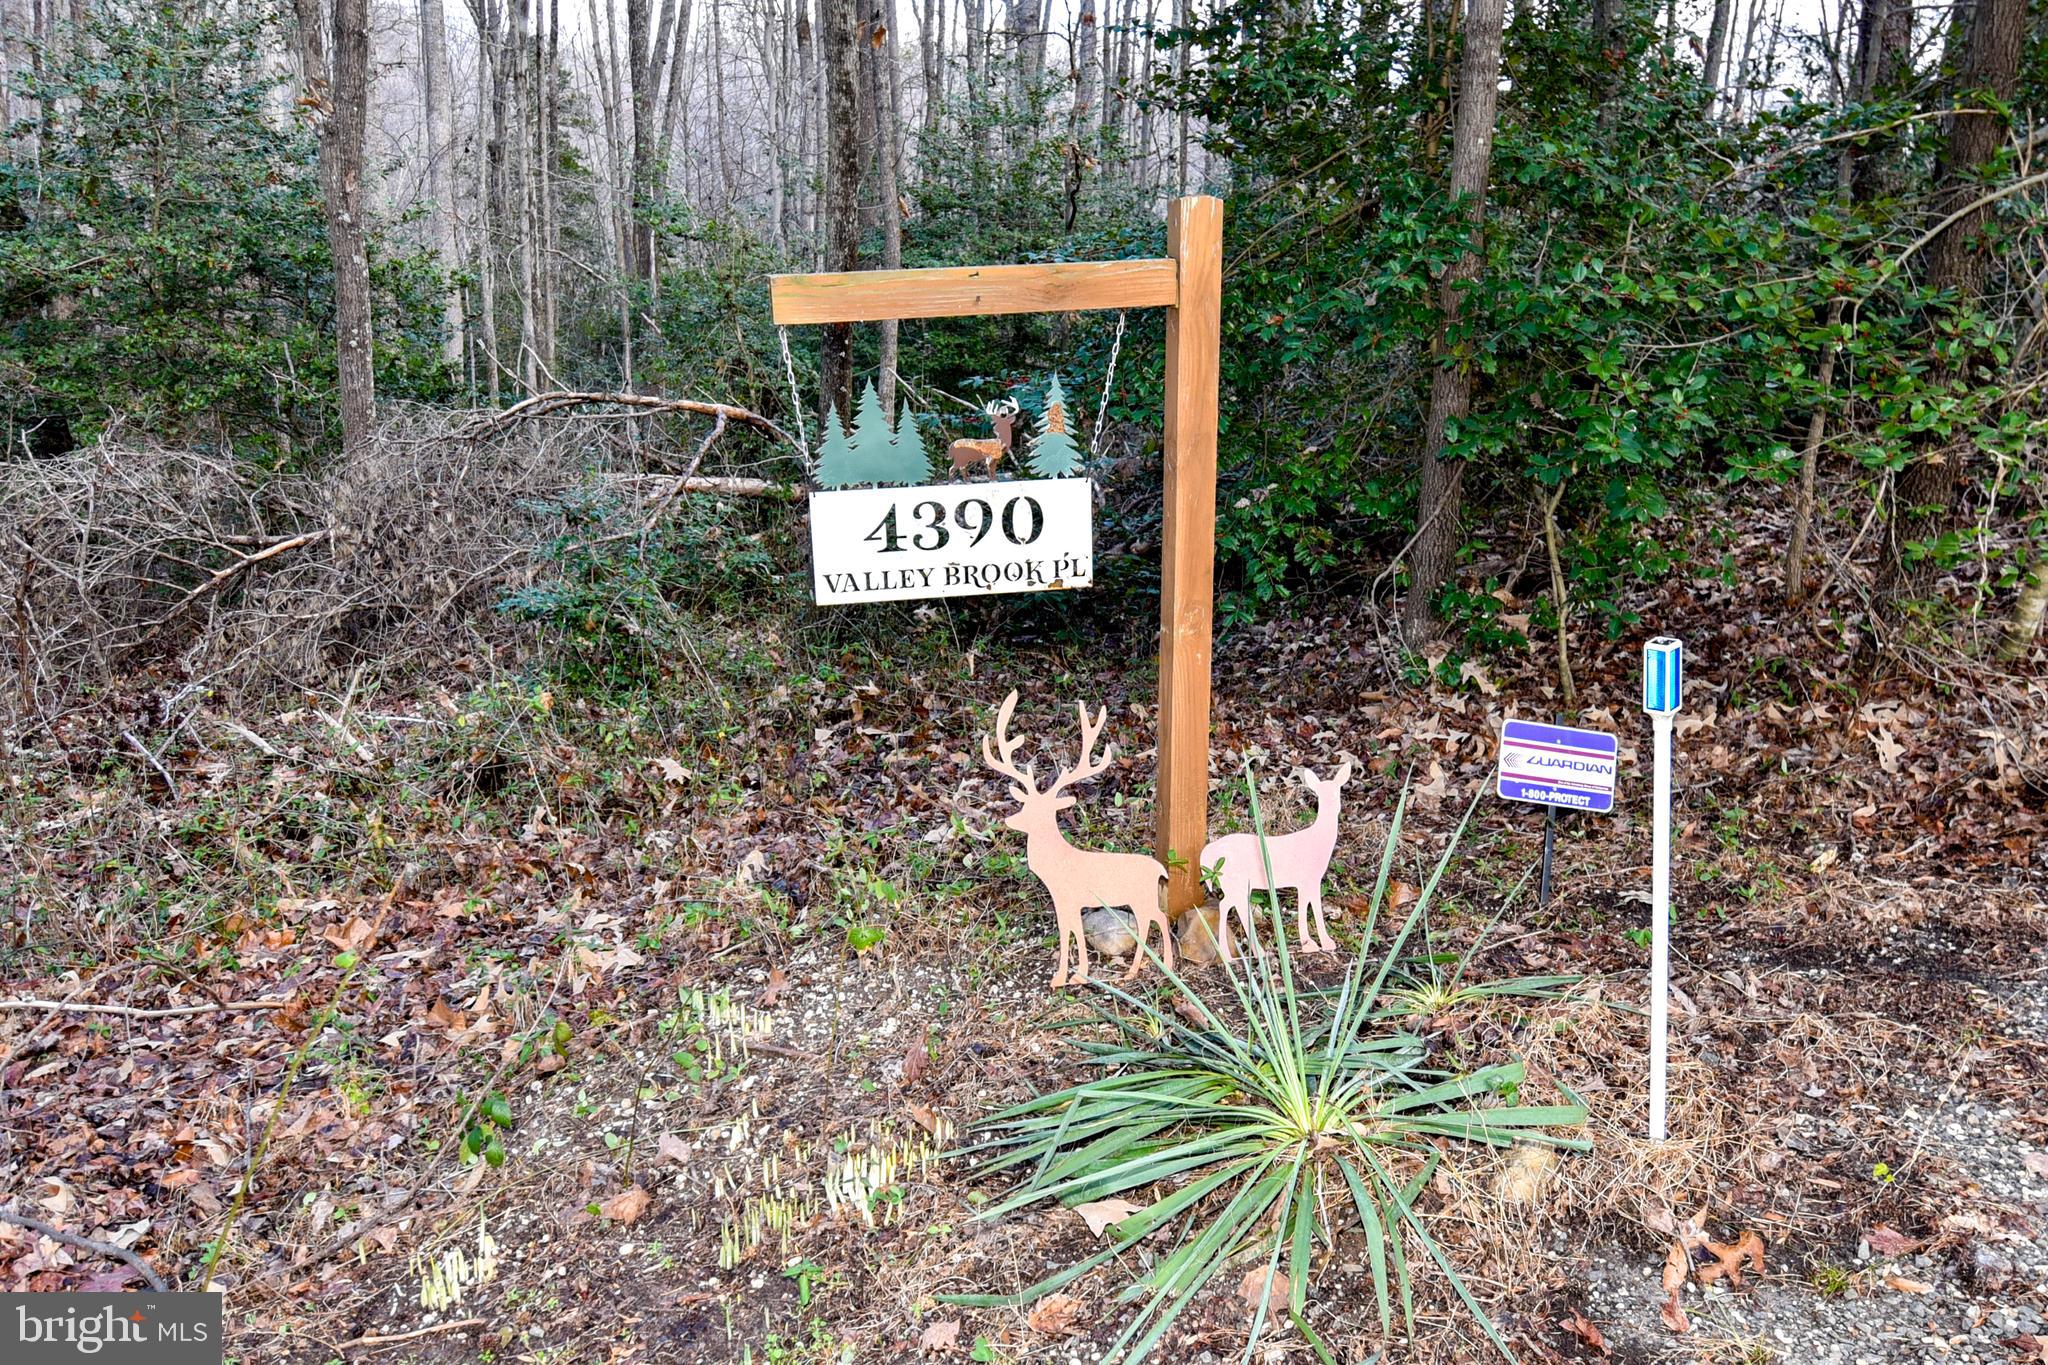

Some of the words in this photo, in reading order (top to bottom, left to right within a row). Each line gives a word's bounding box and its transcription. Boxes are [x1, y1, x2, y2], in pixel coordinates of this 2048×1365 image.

[863, 495, 1044, 553] 4390
[822, 567, 935, 593] VALLEY
[943, 561, 1047, 588] BROOK
[1526, 755, 1612, 775] GUARDIAN
[1521, 788, 1591, 807] 1-800-PROTECT
